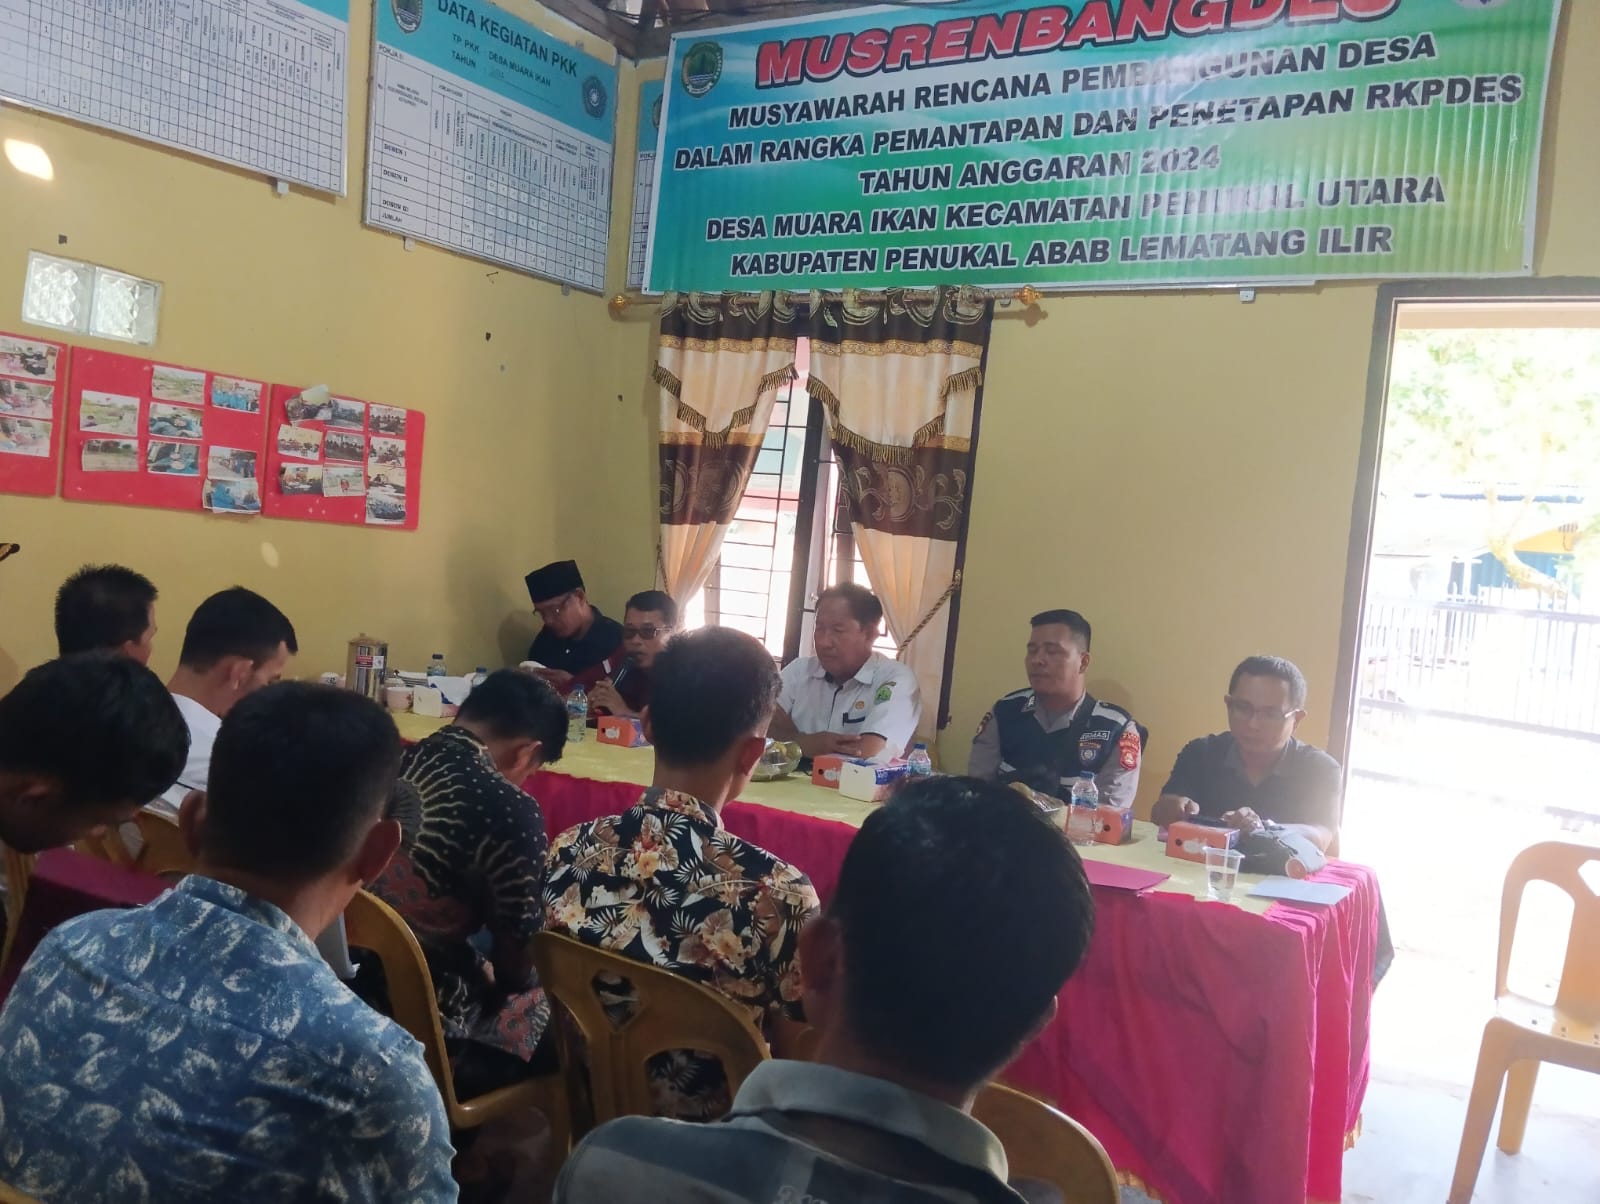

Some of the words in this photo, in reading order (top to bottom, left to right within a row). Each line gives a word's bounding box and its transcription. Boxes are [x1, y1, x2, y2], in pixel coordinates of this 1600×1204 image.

[438, 0, 476, 28] DATA
[480, 15, 548, 62] KEGIATAN
[551, 51, 577, 77] PKK
[451, 51, 477, 68] TAHUN
[464, 39, 480, 53] PKK
[729, 89, 905, 128] MUSYAWARAH
[914, 71, 1051, 112] RENCANA
[1062, 45, 1326, 93] PEMBGUNAN
[1338, 34, 1436, 70] DESA
[674, 143, 752, 170] DALAM
[760, 134, 864, 161] RANGKA
[873, 113, 1062, 154] PEMANTAPAN
[1073, 108, 1137, 136] DAN
[1148, 88, 1354, 130] PENETAPAN
[1366, 74, 1523, 110] RKPDES
[859, 165, 951, 195] TAHUN
[958, 151, 1131, 188] ANGGARAN
[1140, 145, 1220, 174] 2024
[706, 217, 765, 240] DESA
[773, 212, 862, 237] MUARA
[870, 206, 937, 231] IKAN
[945, 195, 1129, 229] KECAMATAN
[1317, 176, 1445, 207] UTARA
[731, 249, 877, 277] KABUPATEN
[885, 243, 1017, 272] PENUKAL
[1025, 239, 1110, 266] ABAB
[1119, 229, 1306, 262] LEMATANG
[1318, 226, 1393, 255] ILIR
